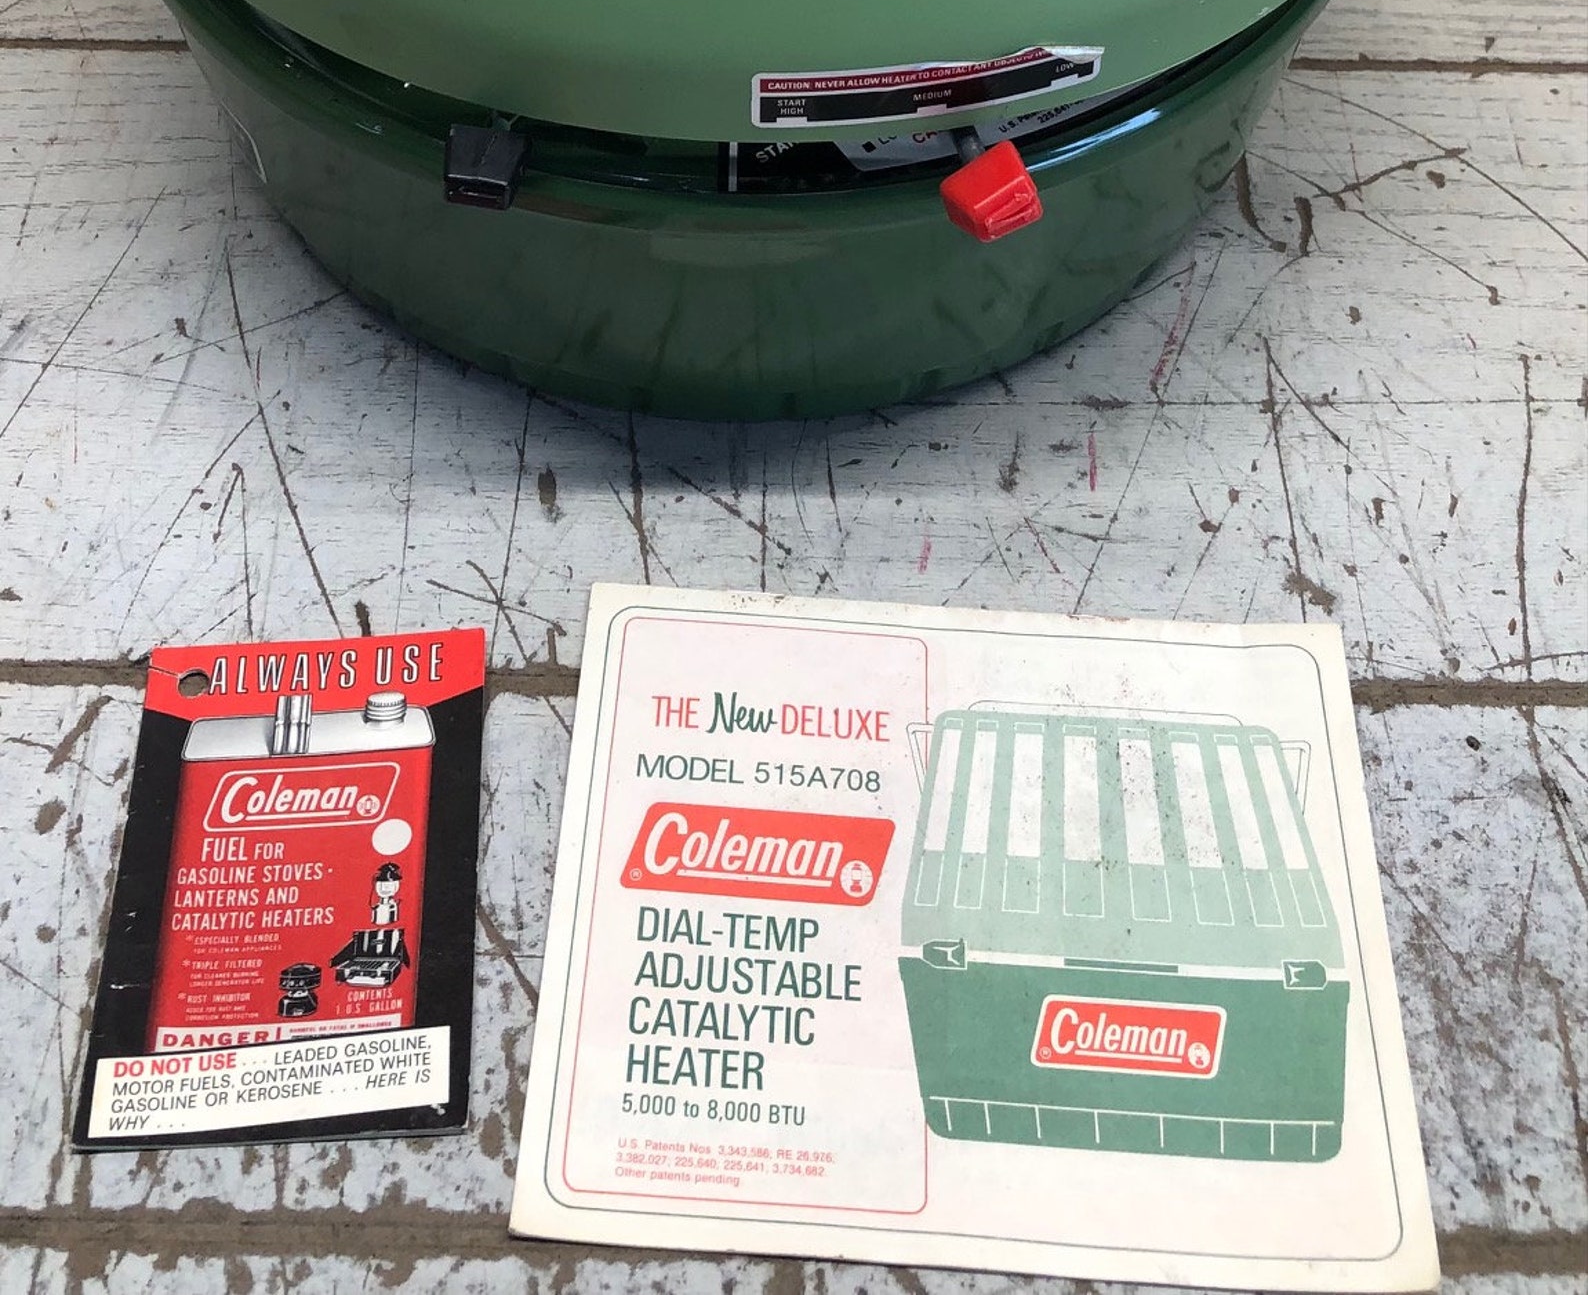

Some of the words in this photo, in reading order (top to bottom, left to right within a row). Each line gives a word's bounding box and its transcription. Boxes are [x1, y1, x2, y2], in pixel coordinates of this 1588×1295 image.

[814, 80, 845, 89] NEVER
[847, 77, 880, 87] ALLOW
[881, 74, 917, 84] HEATER
[918, 71, 930, 80] TO
[931, 66, 972, 78] CONTACT
[1056, 62, 1075, 73] LOW
[777, 99, 806, 107] START
[912, 89, 952, 102] MEDIUM
[780, 107, 805, 115] HIGH
[208, 648, 358, 696] ALWAYS
[374, 641, 443, 686] USE
[651, 695, 700, 728] THE
[706, 692, 777, 733] New
[781, 704, 890, 742] DELUXE
[636, 753, 744, 784] MODEL
[754, 762, 881, 793] 515A708
[221, 774, 358, 824] Coleman
[201, 837, 248, 862] FUEL
[254, 842, 285, 860] FOR
[643, 811, 844, 878] Coleman
[177, 866, 256, 885] GASOLINE
[174, 888, 260, 908] LANTERNS
[265, 886, 299, 905] AND
[171, 911, 256, 931] CATALYTIC
[261, 907, 335, 928] HEATERS
[637, 906, 819, 953] DIAL-TEMP
[194, 935, 240, 945] ESPECIALLY
[244, 933, 280, 944] BLENDED
[192, 960, 219, 970] TRIPLE
[225, 958, 263, 969] FILTERED
[634, 951, 862, 1001] ADJUSTABLE
[187, 995, 207, 1004] RUST
[213, 993, 251, 1003] INHIBITOR
[347, 988, 393, 1003] CONTENTS
[369, 998, 403, 1013] GALLON
[628, 996, 816, 1046] CATALYTIC
[1051, 1008, 1188, 1056] Coleman
[162, 1027, 282, 1047] DANGER!
[113, 1061, 144, 1079] DO
[150, 1056, 193, 1077] NOT
[198, 1051, 237, 1072] USE
[274, 1046, 337, 1066] LEADED
[344, 1035, 432, 1058] GASOLINE,
[626, 1043, 765, 1090] HEATER
[112, 1077, 174, 1096] MOTOR
[241, 1061, 374, 1086] CONTAMINATED
[380, 1051, 431, 1071] WHITE
[111, 1094, 198, 1114] GASOLINE
[205, 1091, 229, 1107] OR
[236, 1080, 322, 1103] KEROSENE
[365, 1071, 407, 1090] HERE
[414, 1068, 431, 1084] IS
[621, 1093, 676, 1116] 5,000
[683, 1100, 699, 1118] to
[707, 1099, 761, 1123] 8,000
[769, 1104, 805, 1126] BTU
[108, 1115, 150, 1132] WHY
[645, 1139, 685, 1153] Patents
[777, 1149, 793, 1161] RE
[615, 1166, 646, 1178] Other
[650, 1170, 691, 1182] patents
